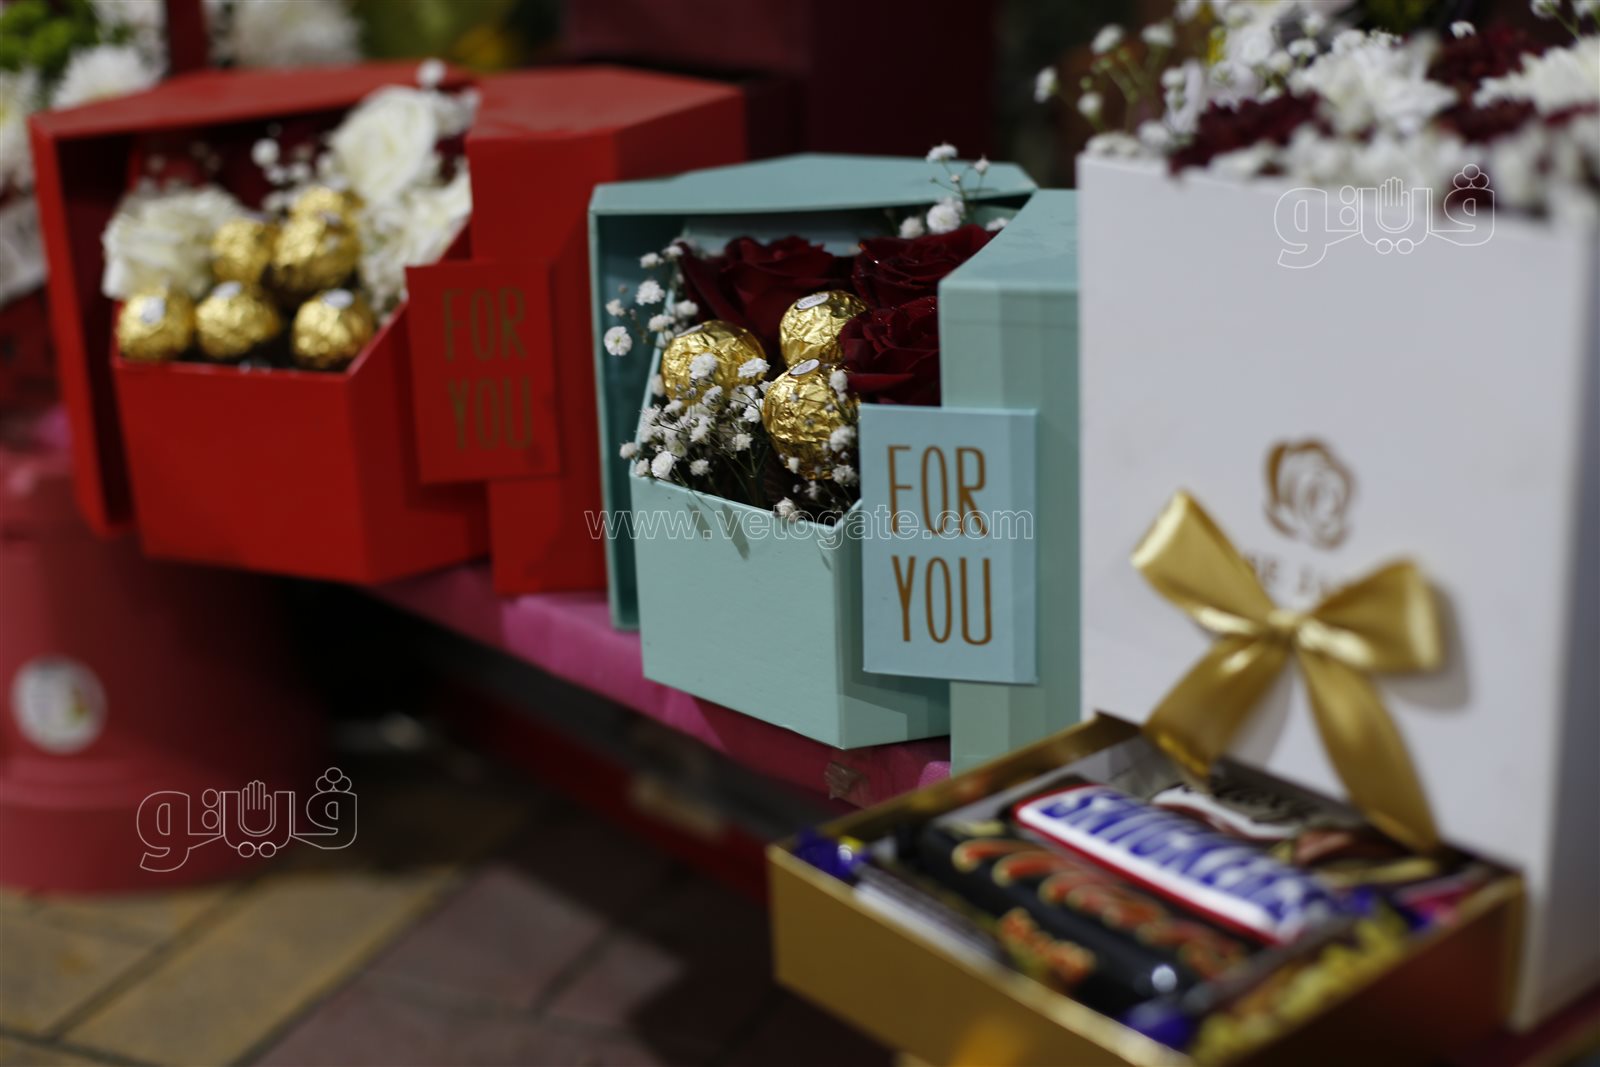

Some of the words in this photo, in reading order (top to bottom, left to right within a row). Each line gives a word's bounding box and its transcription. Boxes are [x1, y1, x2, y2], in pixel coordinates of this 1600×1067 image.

[442, 287, 528, 362] FOR
[448, 376, 533, 450] YOU
[887, 445, 989, 537] FOR
[892, 555, 992, 646] YOU
